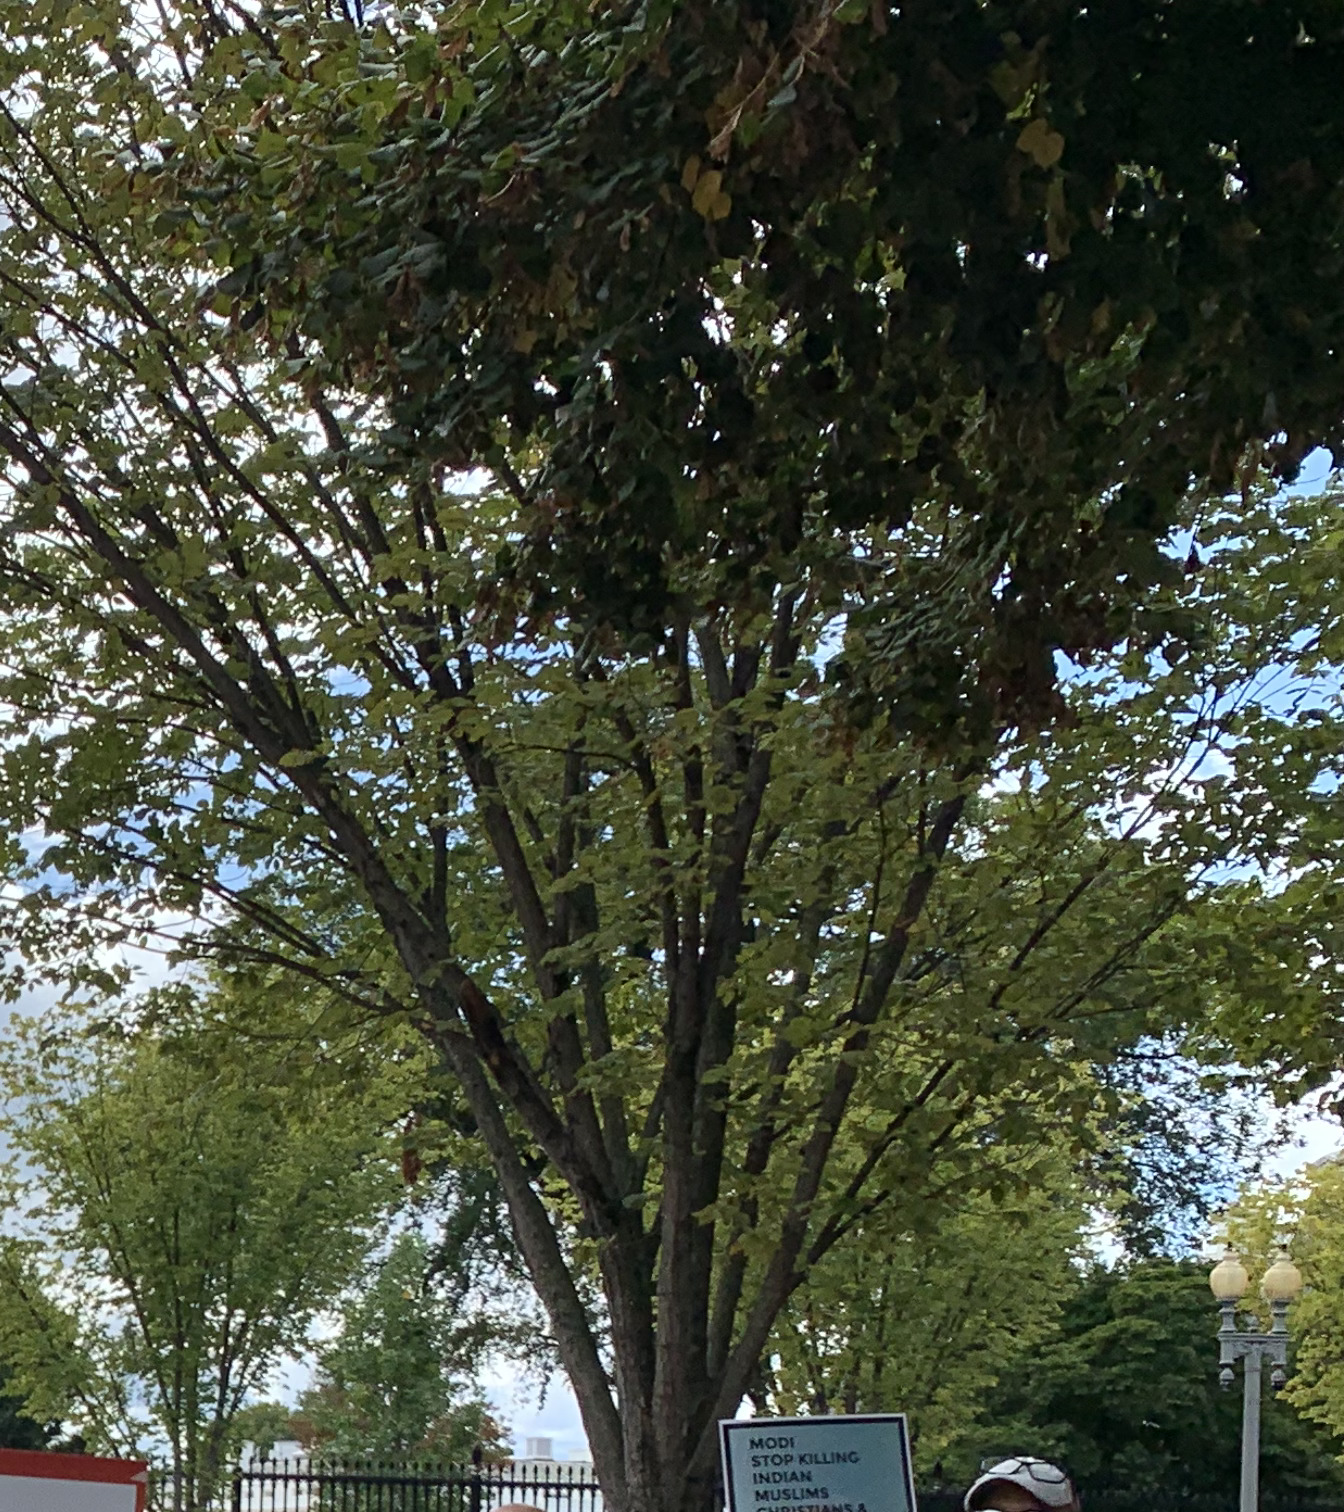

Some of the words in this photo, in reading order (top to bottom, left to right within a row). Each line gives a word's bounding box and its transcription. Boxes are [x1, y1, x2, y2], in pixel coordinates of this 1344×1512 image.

[749, 1437, 796, 1450] MODI
[751, 1454, 794, 1468] STOP
[798, 1451, 860, 1465] KILLING
[753, 1470, 812, 1485] INDIAN
[755, 1487, 829, 1502] MUSLIMS
